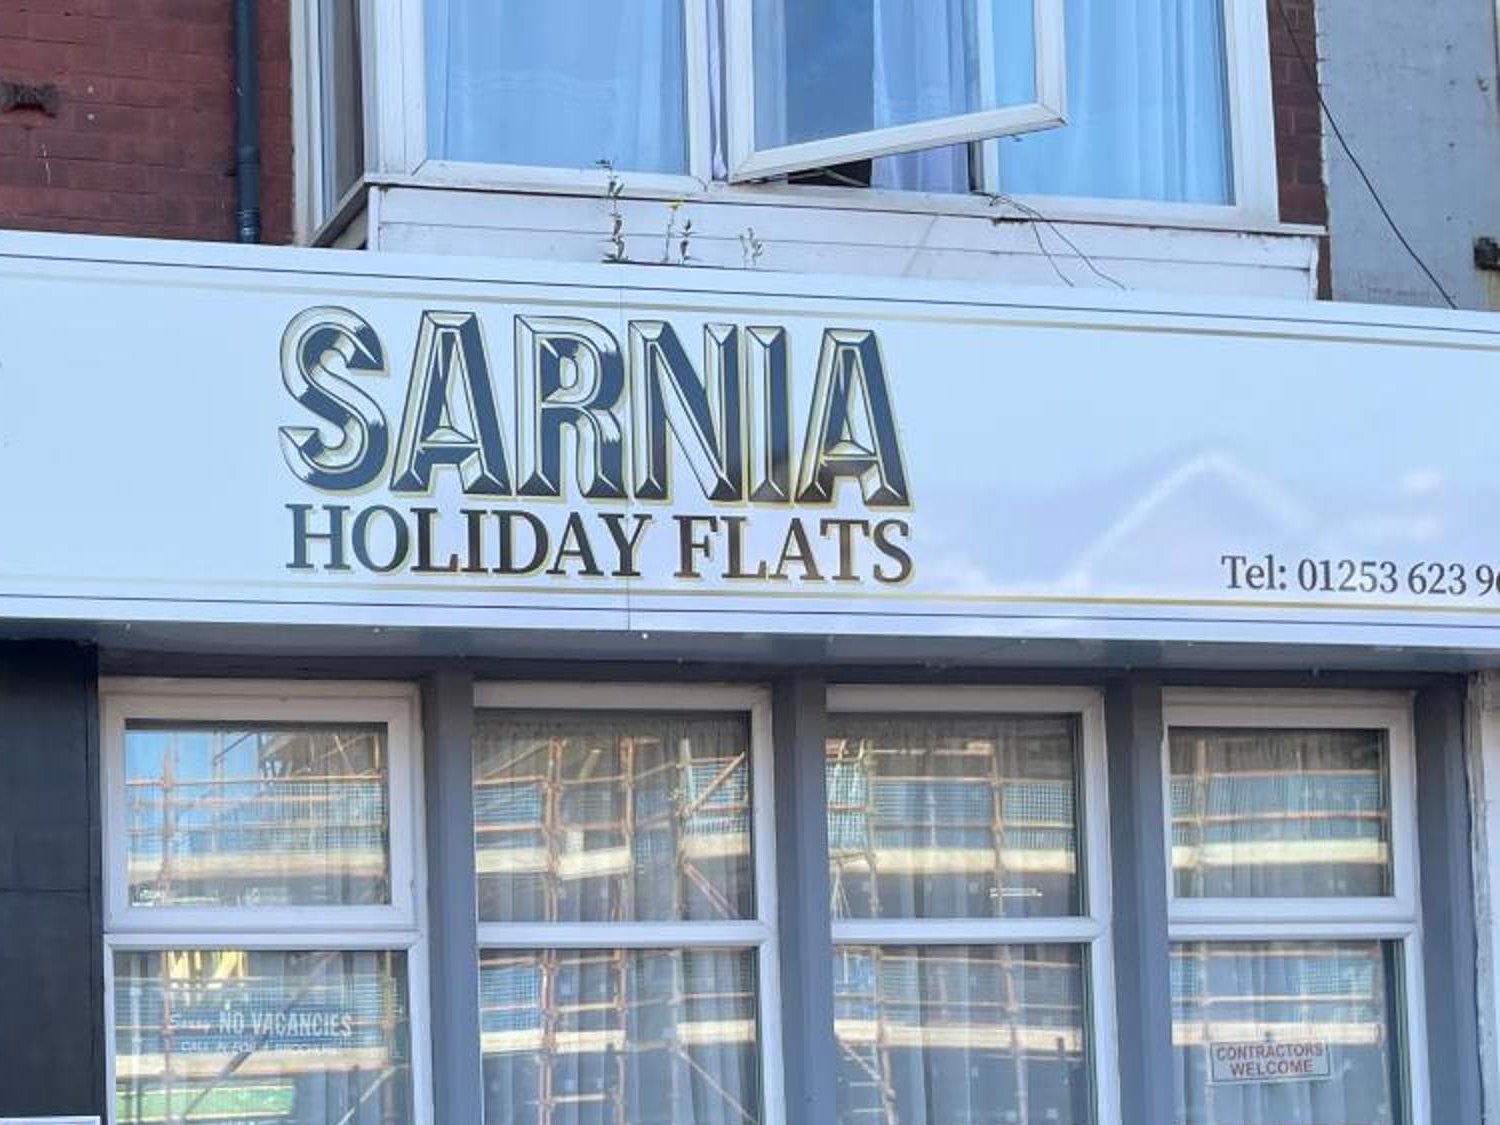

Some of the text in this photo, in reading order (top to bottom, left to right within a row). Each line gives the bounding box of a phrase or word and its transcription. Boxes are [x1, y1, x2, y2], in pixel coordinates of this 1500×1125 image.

[278, 304, 915, 509] SARNIA
[285, 503, 914, 585] HOLIDAY FLATS
[1220, 553, 1500, 597] Tel: 01253 623 9
[220, 1010, 244, 1035] NO
[251, 1010, 353, 1037] VACANCIES
[1216, 1043, 1323, 1062] CONTRACTORS
[1229, 1059, 1315, 1077] WELCOME
